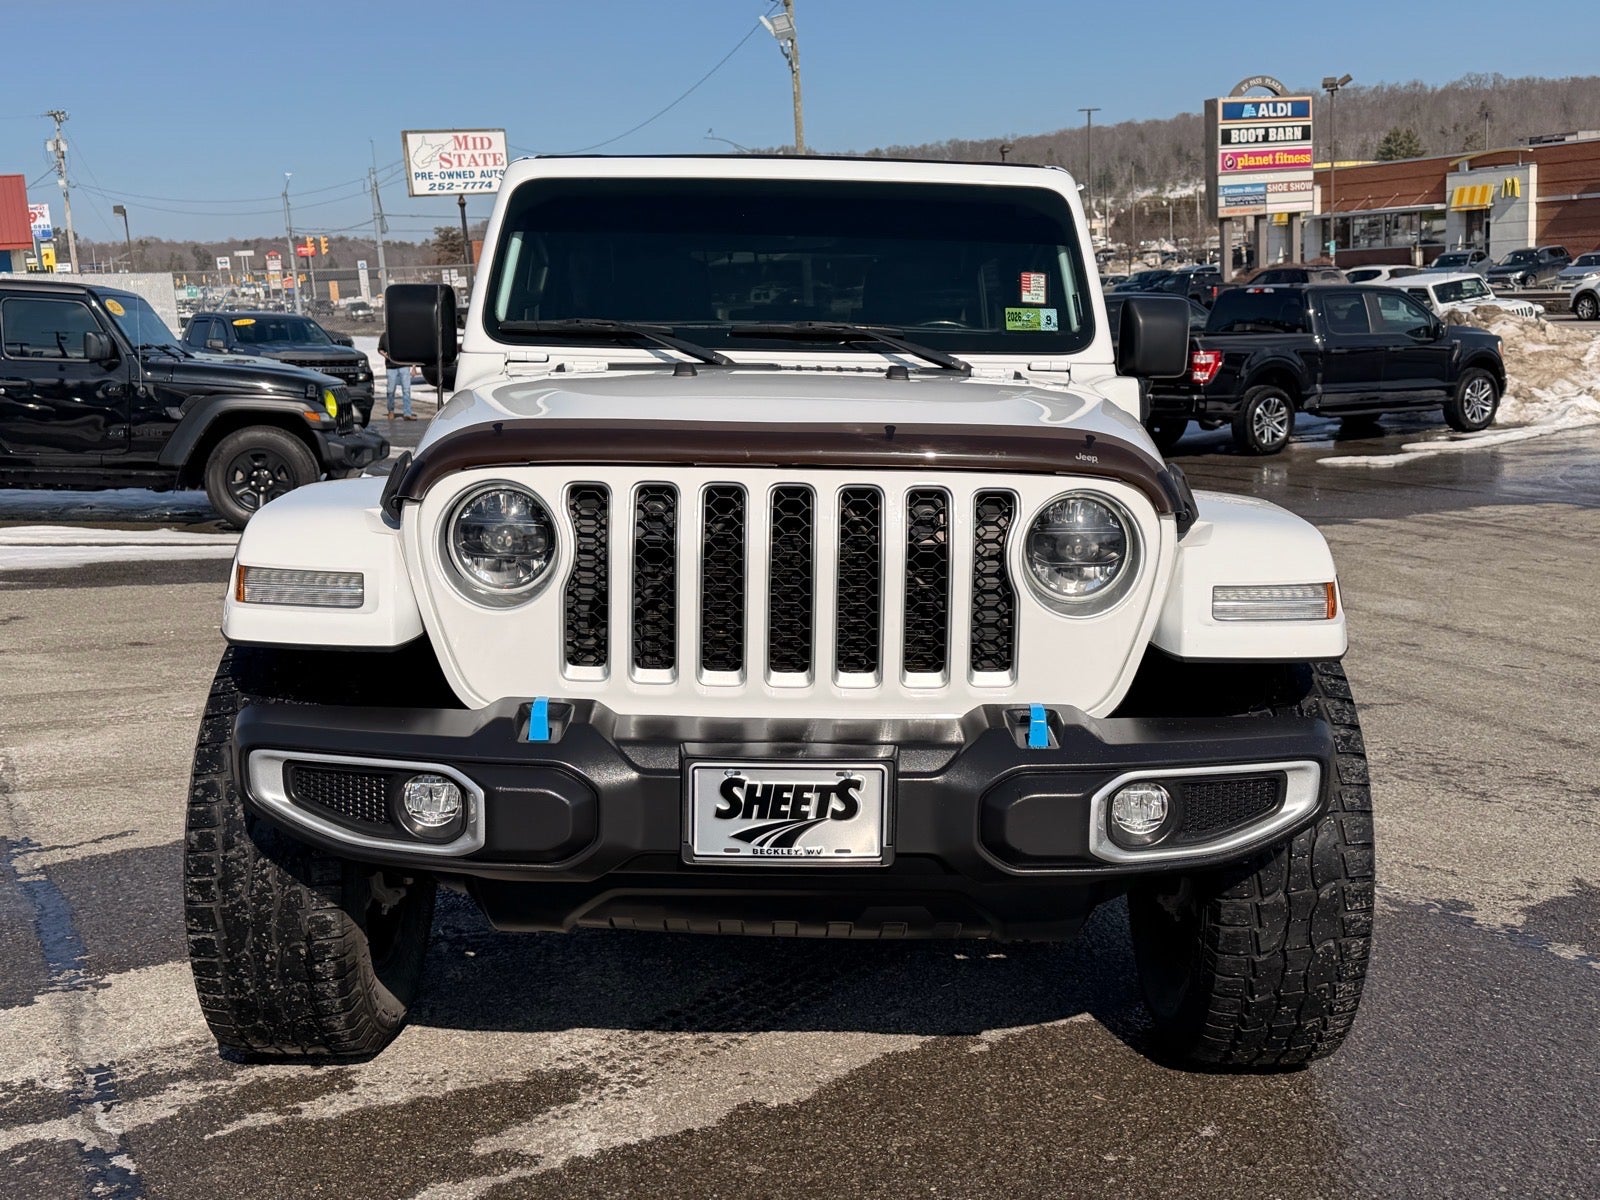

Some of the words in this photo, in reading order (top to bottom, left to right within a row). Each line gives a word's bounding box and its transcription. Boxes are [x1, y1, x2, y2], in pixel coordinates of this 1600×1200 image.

[1258, 103, 1292, 117] ALDI
[1230, 128, 1265, 143] BOOT
[1268, 127, 1303, 141] BARN
[452, 135, 493, 151] MID
[438, 152, 505, 169] STATE
[1237, 153, 1273, 169] planet
[1275, 152, 1311, 165] fitness
[414, 171, 475, 181] PRE-OWNED
[428, 181, 493, 191] 252-7774
[1267, 183, 1288, 193] SHOE
[1290, 181, 1313, 191] SHOW
[1007, 311, 1022, 322] 2026
[1045, 315, 1052, 325] 9
[1075, 452, 1099, 464] Jeep
[714, 777, 862, 821] SHEETS
